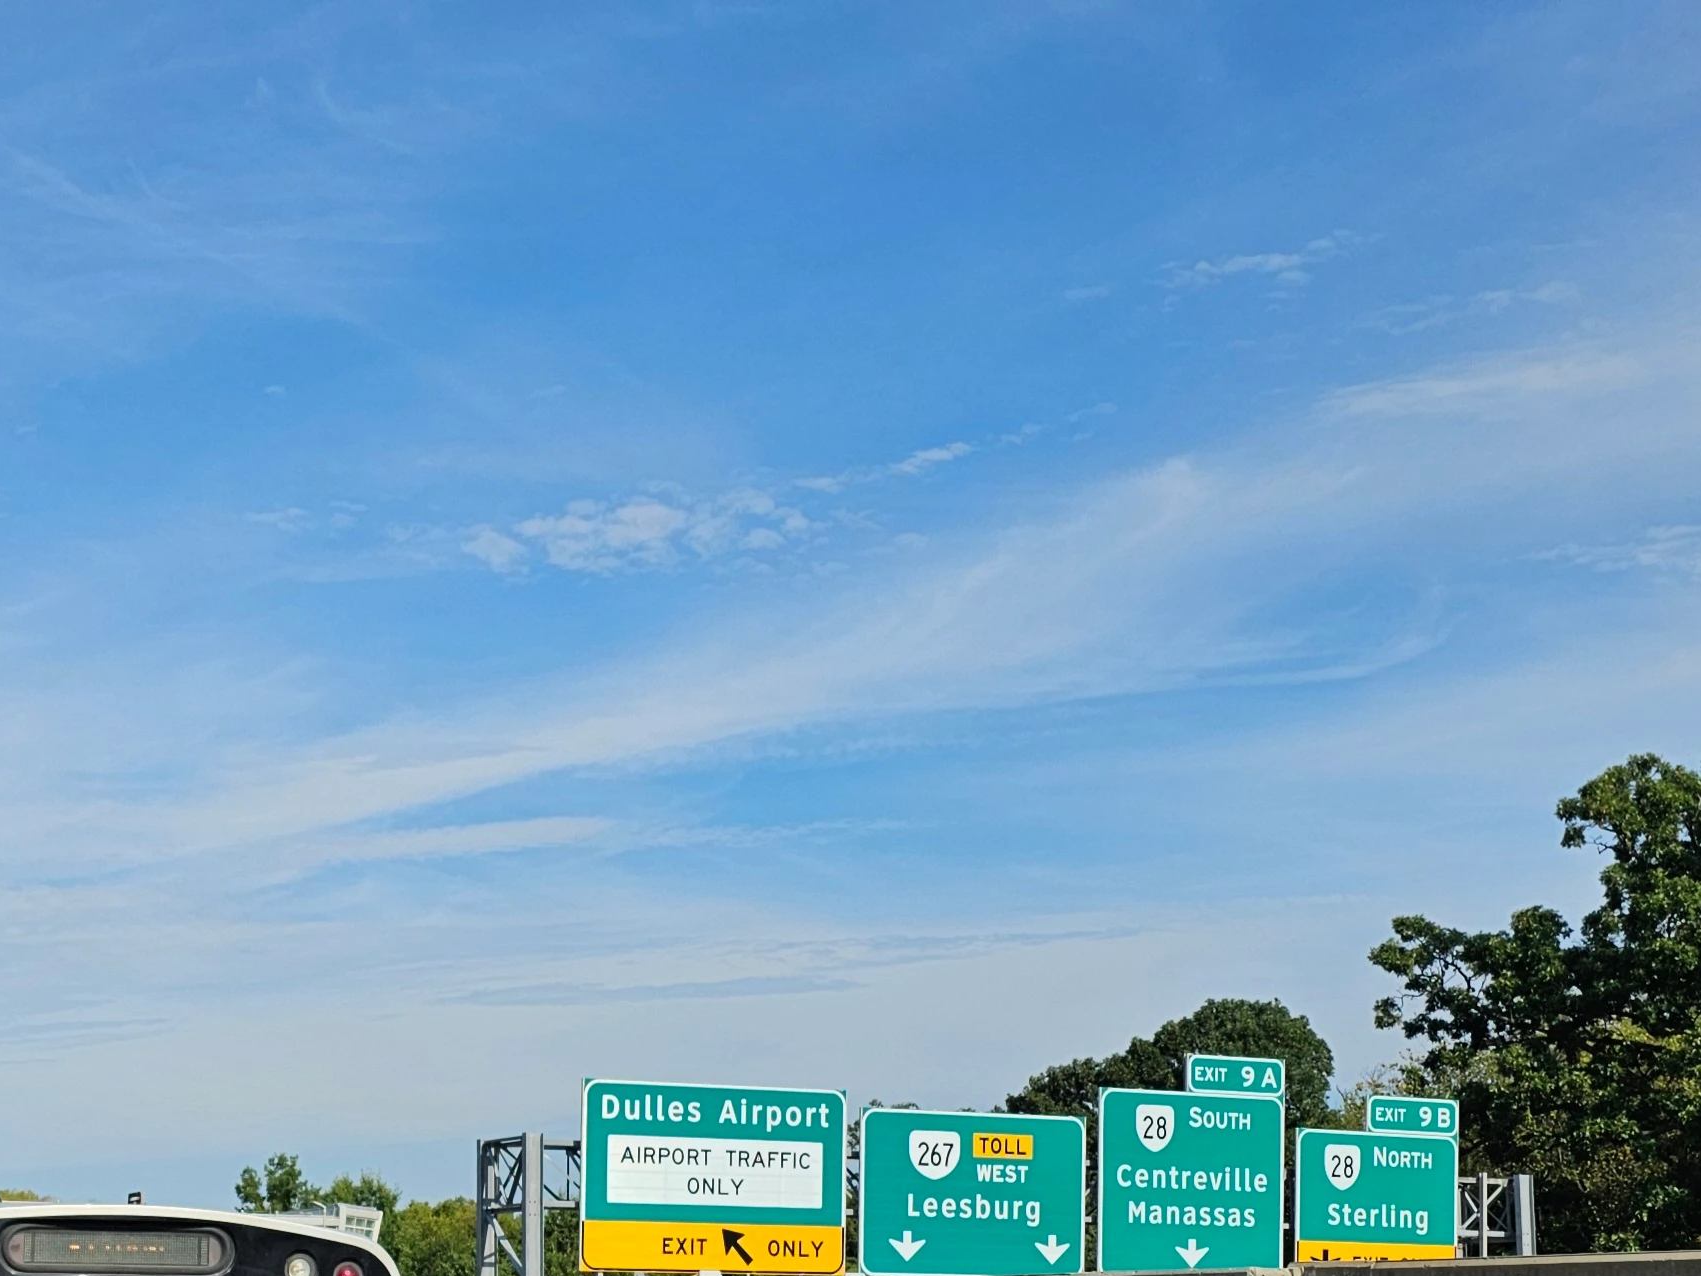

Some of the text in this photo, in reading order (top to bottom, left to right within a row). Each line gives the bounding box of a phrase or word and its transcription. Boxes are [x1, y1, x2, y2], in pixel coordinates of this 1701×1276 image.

[1194, 1066, 1278, 1088] EXIT 9 A
[601, 1094, 830, 1132] Dulles Airport
[1189, 1106, 1251, 1130] SOUTH
[1375, 1106, 1451, 1128] EXIT 9 B
[1143, 1115, 1167, 1140] 28
[621, 1146, 811, 1169] AIRPORT TRAFFIC
[917, 1141, 954, 1167] 267
[979, 1137, 1026, 1155] TOLL
[1373, 1146, 1432, 1169] NORTH
[976, 1164, 1029, 1183] WEST
[1116, 1164, 1268, 1192] Centreville
[1331, 1155, 1354, 1178] 28
[687, 1177, 744, 1196] ONLY
[907, 1193, 1041, 1227] Leesburg
[1128, 1201, 1256, 1228] Manassas
[1327, 1203, 1429, 1235] Sterling
[662, 1237, 824, 1257] EXIT ONLY
